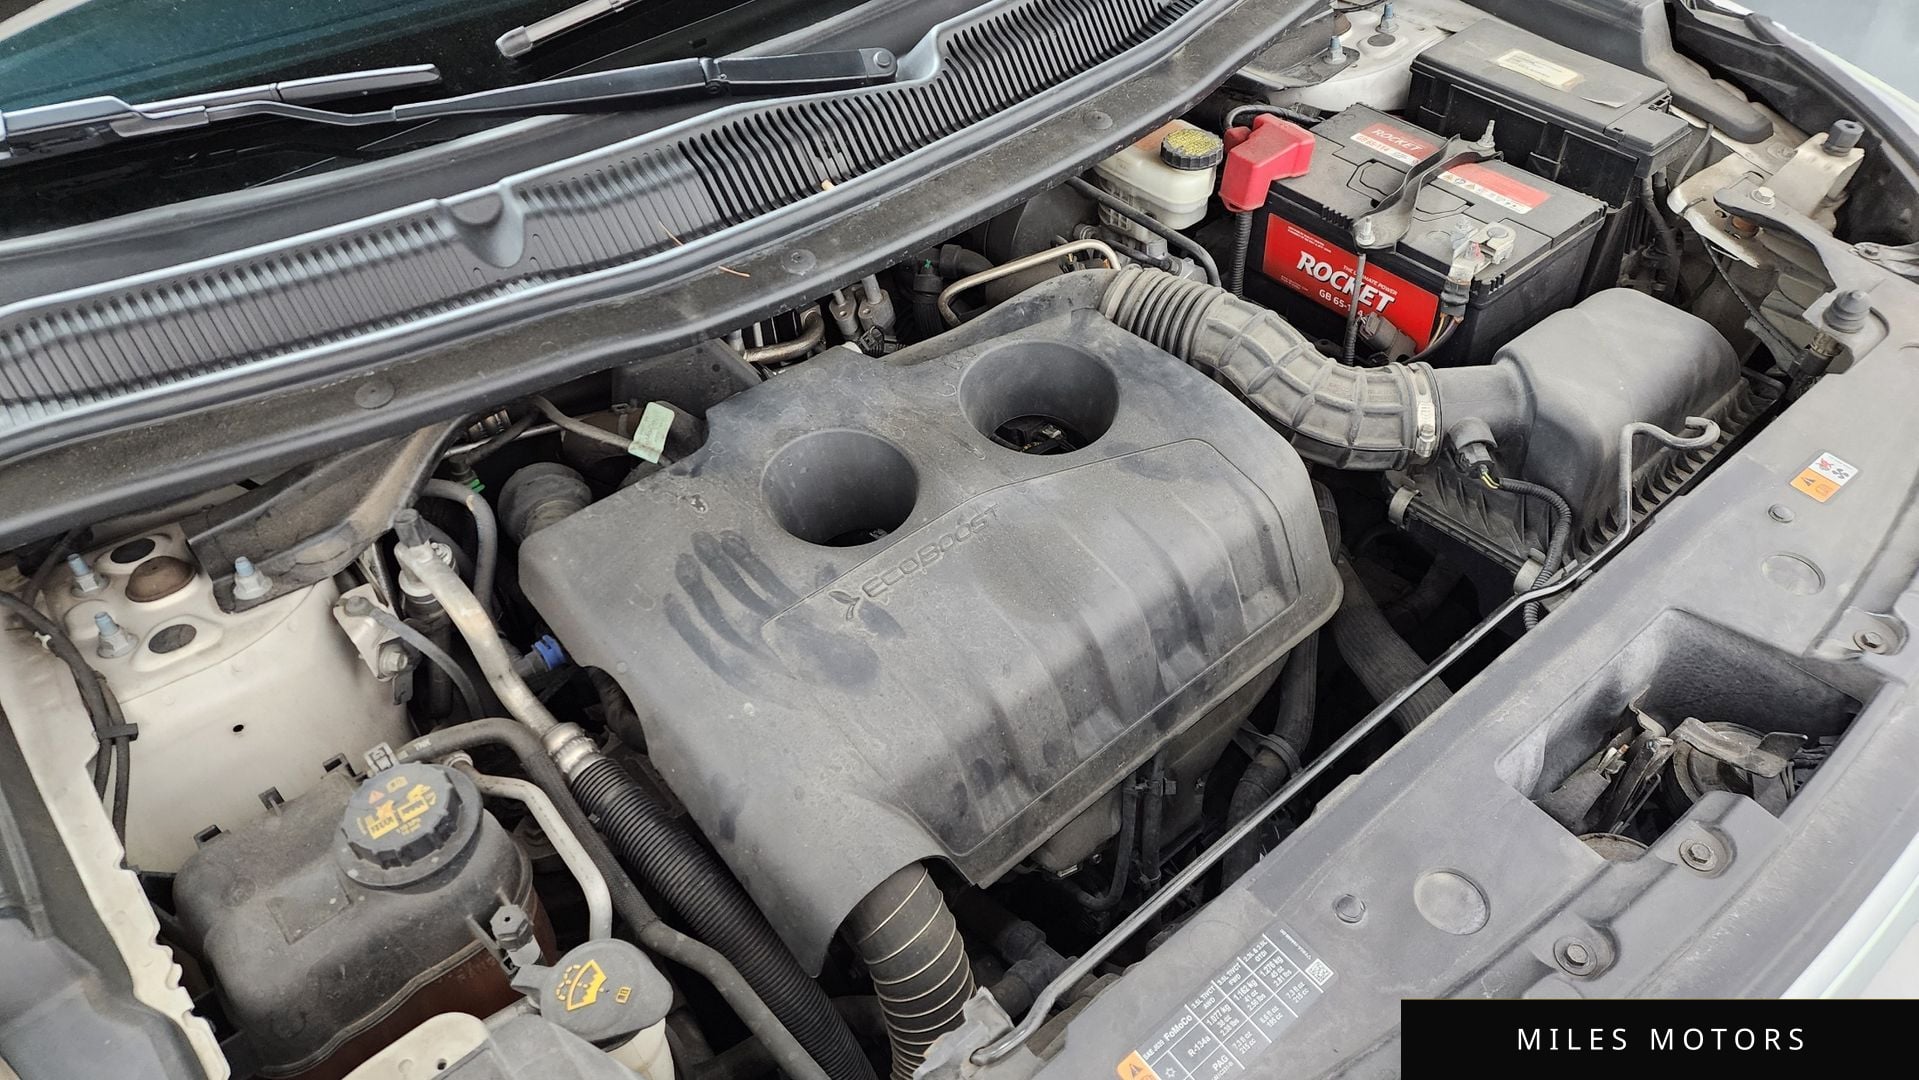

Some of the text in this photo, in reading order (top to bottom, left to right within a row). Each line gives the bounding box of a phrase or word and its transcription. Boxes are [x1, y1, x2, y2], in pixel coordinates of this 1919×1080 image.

[1371, 129, 1424, 151] ROCKET
[1296, 250, 1396, 313] ROCKET
[1343, 265, 1354, 275] THE
[1378, 282, 1398, 296] POWER
[1319, 288, 1332, 302] GB
[1260, 955, 1284, 977] 1.276 kg
[1228, 973, 1241, 986] FWD
[1233, 978, 1259, 1001] 1.162 kg
[1203, 996, 1216, 1009] AWD
[1206, 1003, 1232, 1026] 1.077 kg
[1163, 1014, 1193, 1042] FoMoCo
[1187, 1035, 1212, 1058] R-134a
[1211, 1054, 1229, 1072] PAG
